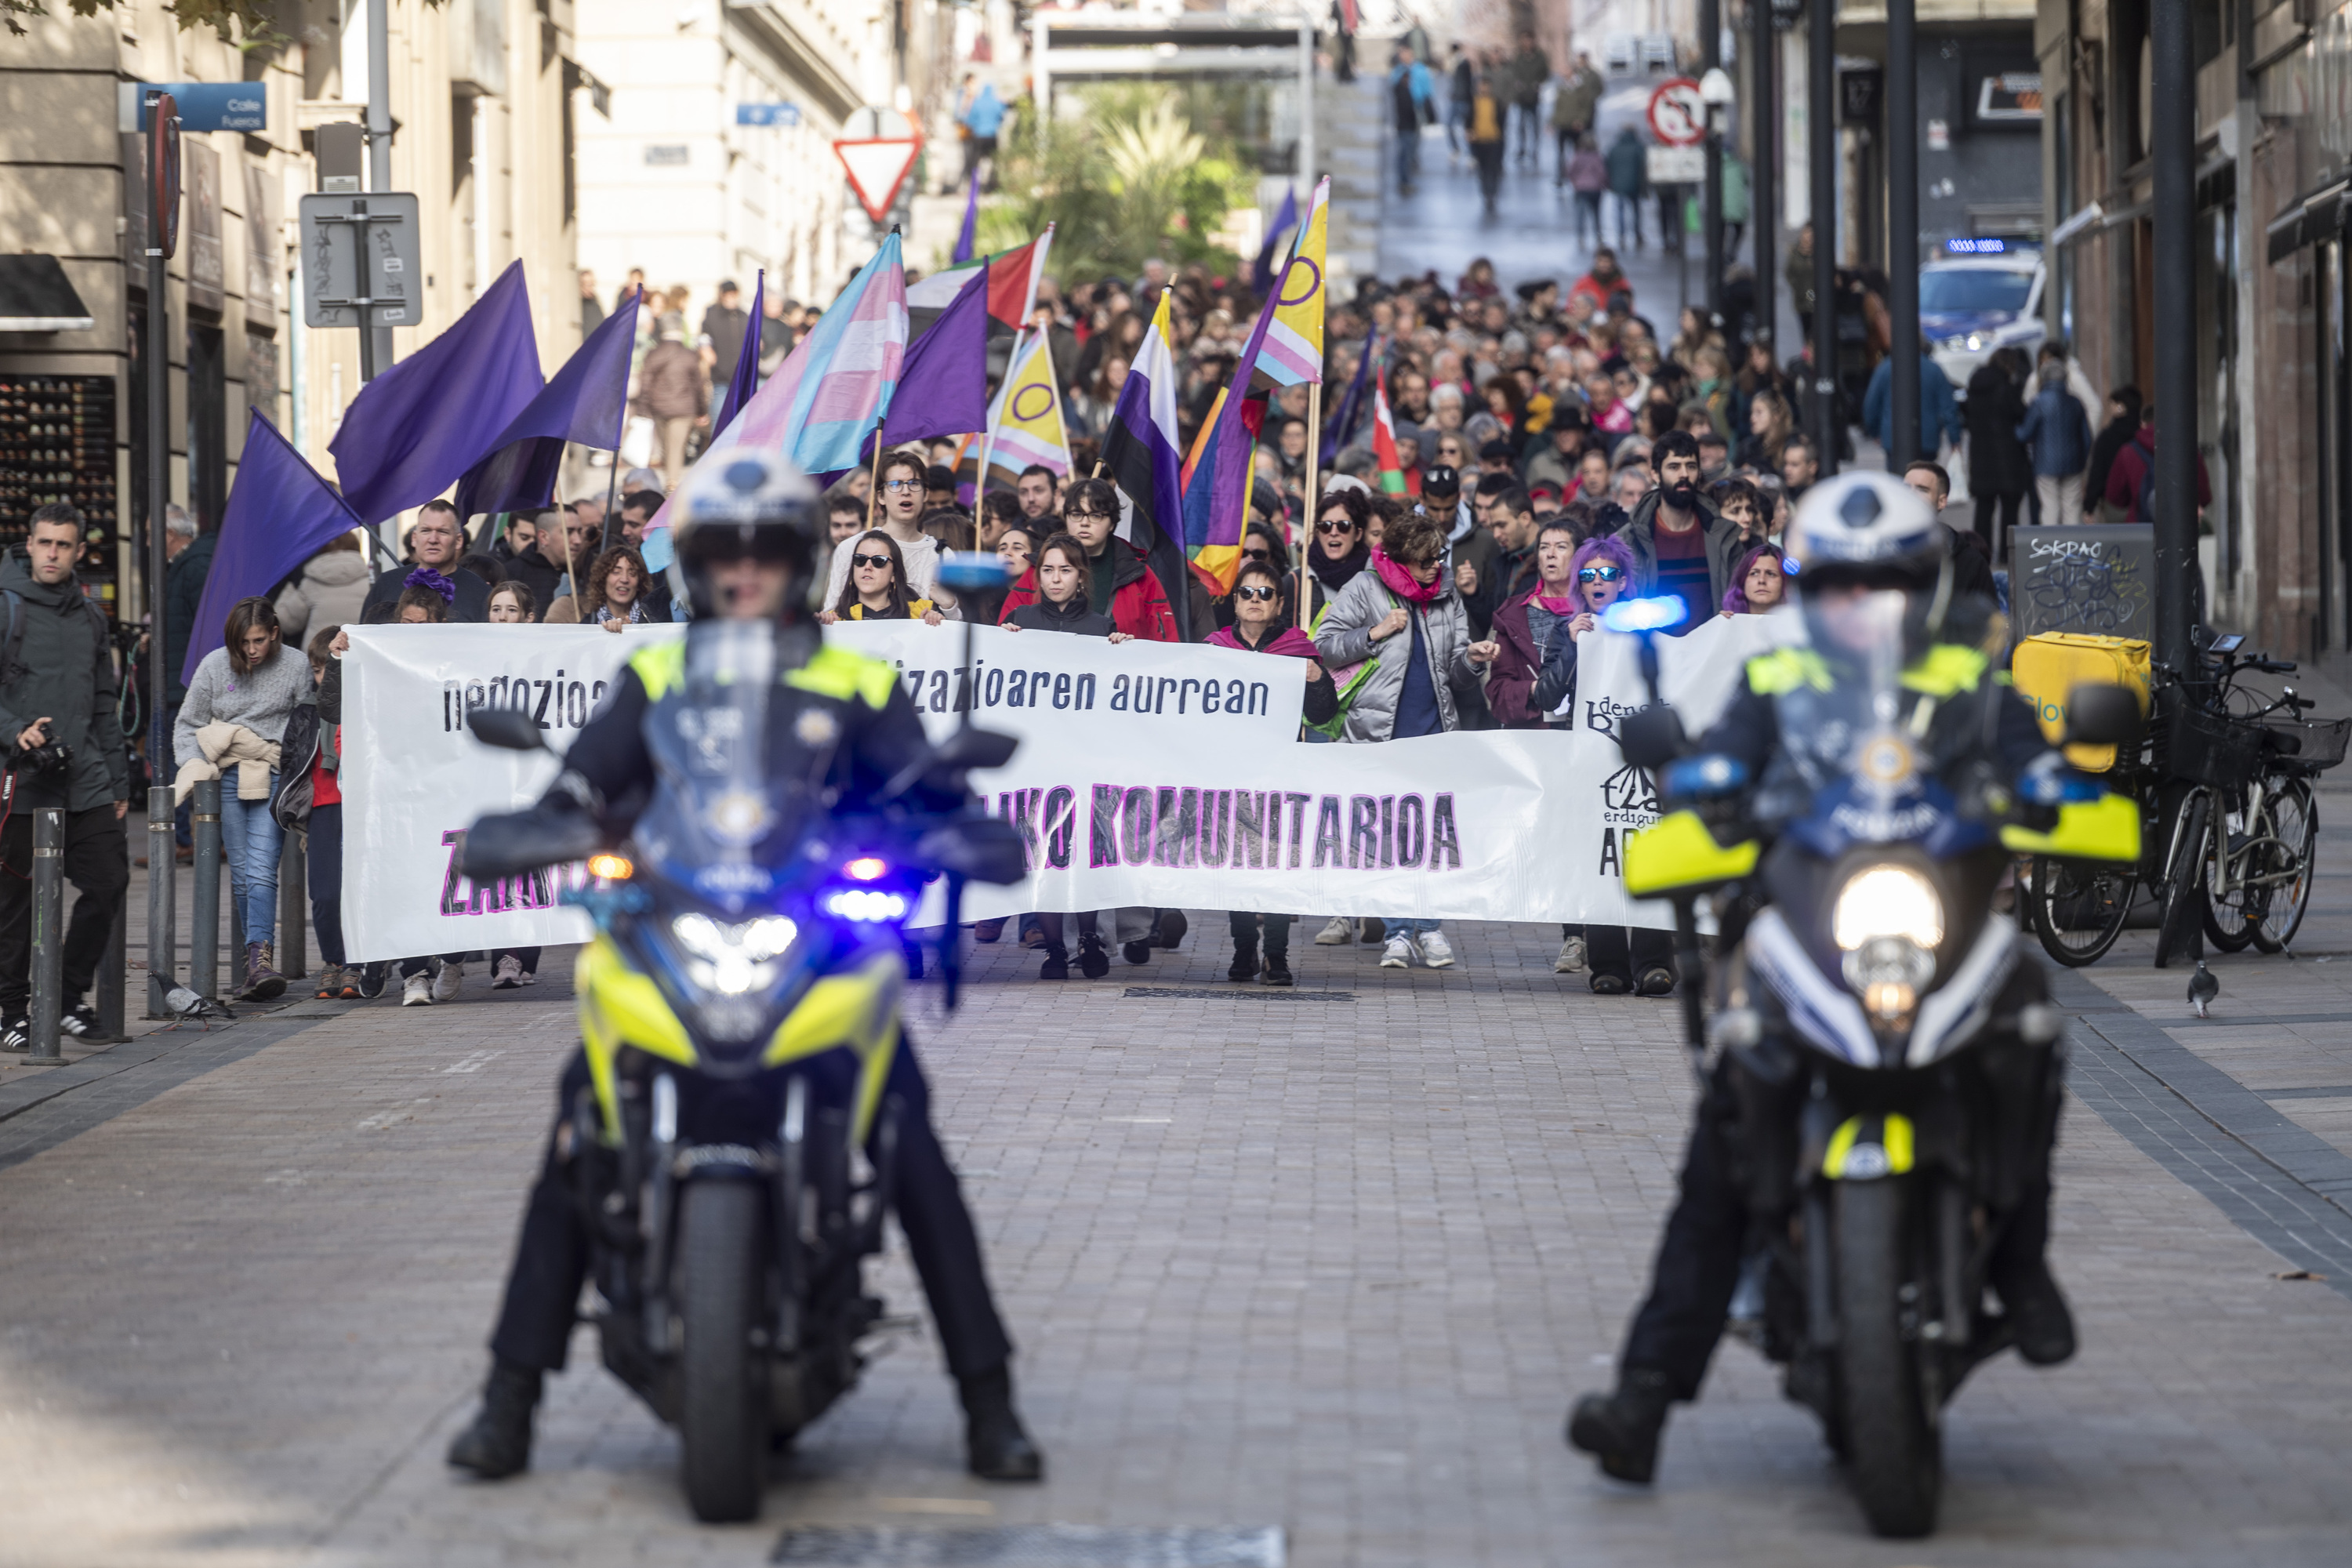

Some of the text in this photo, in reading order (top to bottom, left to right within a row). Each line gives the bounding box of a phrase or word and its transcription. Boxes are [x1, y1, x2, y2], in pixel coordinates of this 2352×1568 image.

[1110, 673, 1269, 717] aurrean
[2, 775, 13, 800] Canon
[1089, 782, 1464, 872] KOMUNITARIOA
